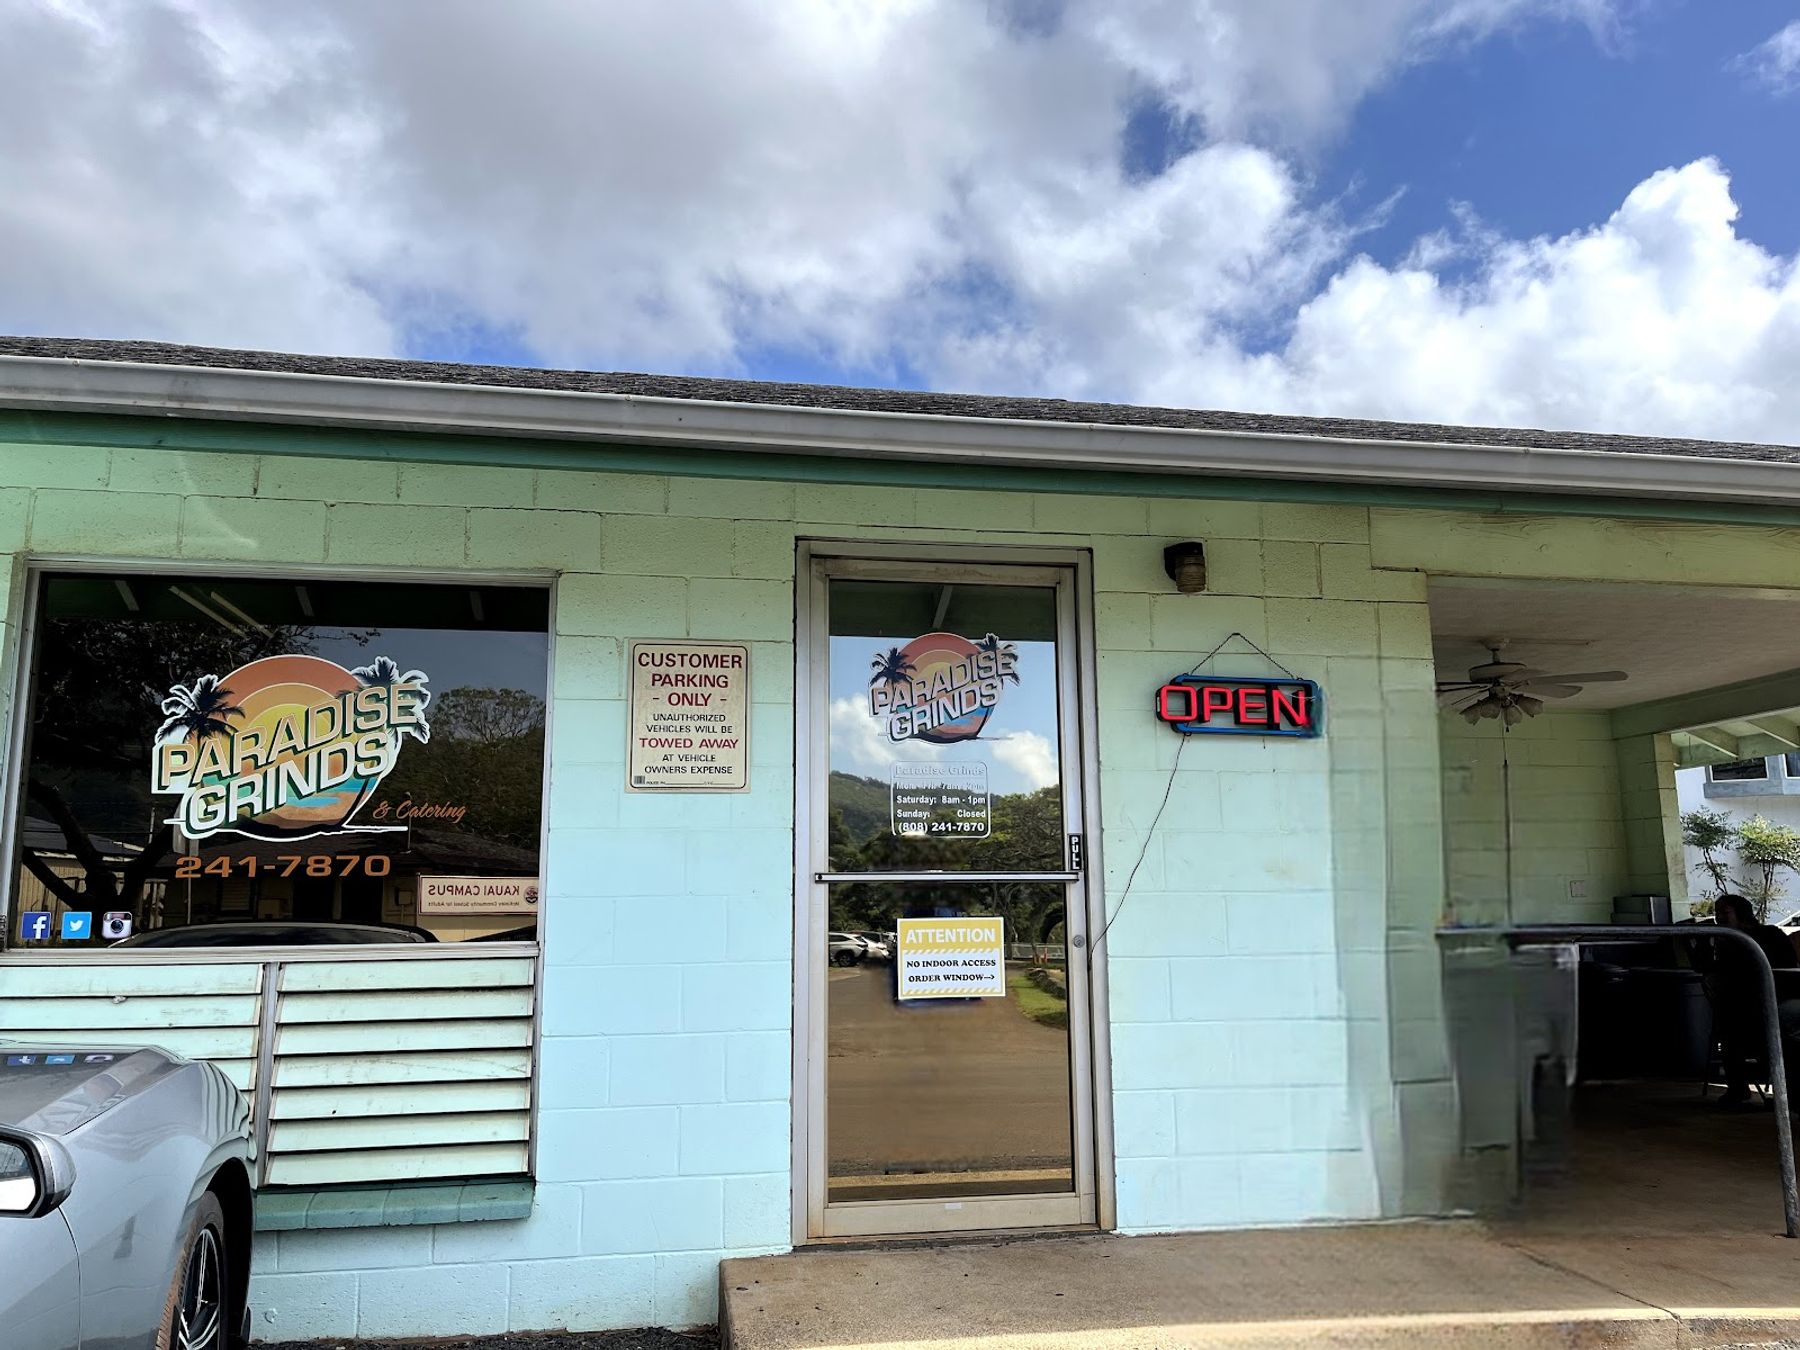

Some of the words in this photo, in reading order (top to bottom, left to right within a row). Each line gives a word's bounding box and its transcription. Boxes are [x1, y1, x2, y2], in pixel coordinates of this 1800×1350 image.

[638, 652, 743, 669] CUSTOMER
[651, 673, 729, 689] PARKING
[872, 650, 1014, 715] PARADISE
[668, 692, 713, 707] ONLY
[1159, 685, 1307, 726] OPEN
[889, 679, 999, 741] GRINDS
[652, 713, 726, 723] UNAUTHORIZED
[159, 683, 421, 789] PARADISE
[646, 725, 691, 734] VEHICLES
[694, 725, 718, 734] WILL
[721, 726, 733, 734] BE
[639, 738, 693, 749] TOWED
[699, 738, 739, 749] AWAY
[662, 754, 674, 762] AT
[678, 754, 716, 762] VEHICLE
[644, 766, 688, 774] OWNERS
[690, 766, 733, 774] EXPENSE
[895, 765, 945, 776] Paradise
[949, 765, 985, 776] Grinds
[187, 732, 389, 832] GRINDS
[896, 795, 937, 806] Saturday:
[941, 795, 960, 804] 8am
[968, 795, 986, 806] 1pm
[372, 801, 390, 819] &
[396, 800, 467, 824] Catering
[896, 809, 931, 820] Sunday:
[957, 809, 986, 818] Closed
[898, 822, 928, 836] (808)
[931, 822, 985, 832] 241-7870
[1072, 836, 1080, 870] PULL
[175, 855, 391, 879] 241-7870
[905, 927, 996, 944] ATTENTION
[906, 960, 920, 968] NO
[922, 959, 959, 968] INDOOR
[960, 959, 996, 967] ACCESS
[908, 974, 941, 983] ORDER
